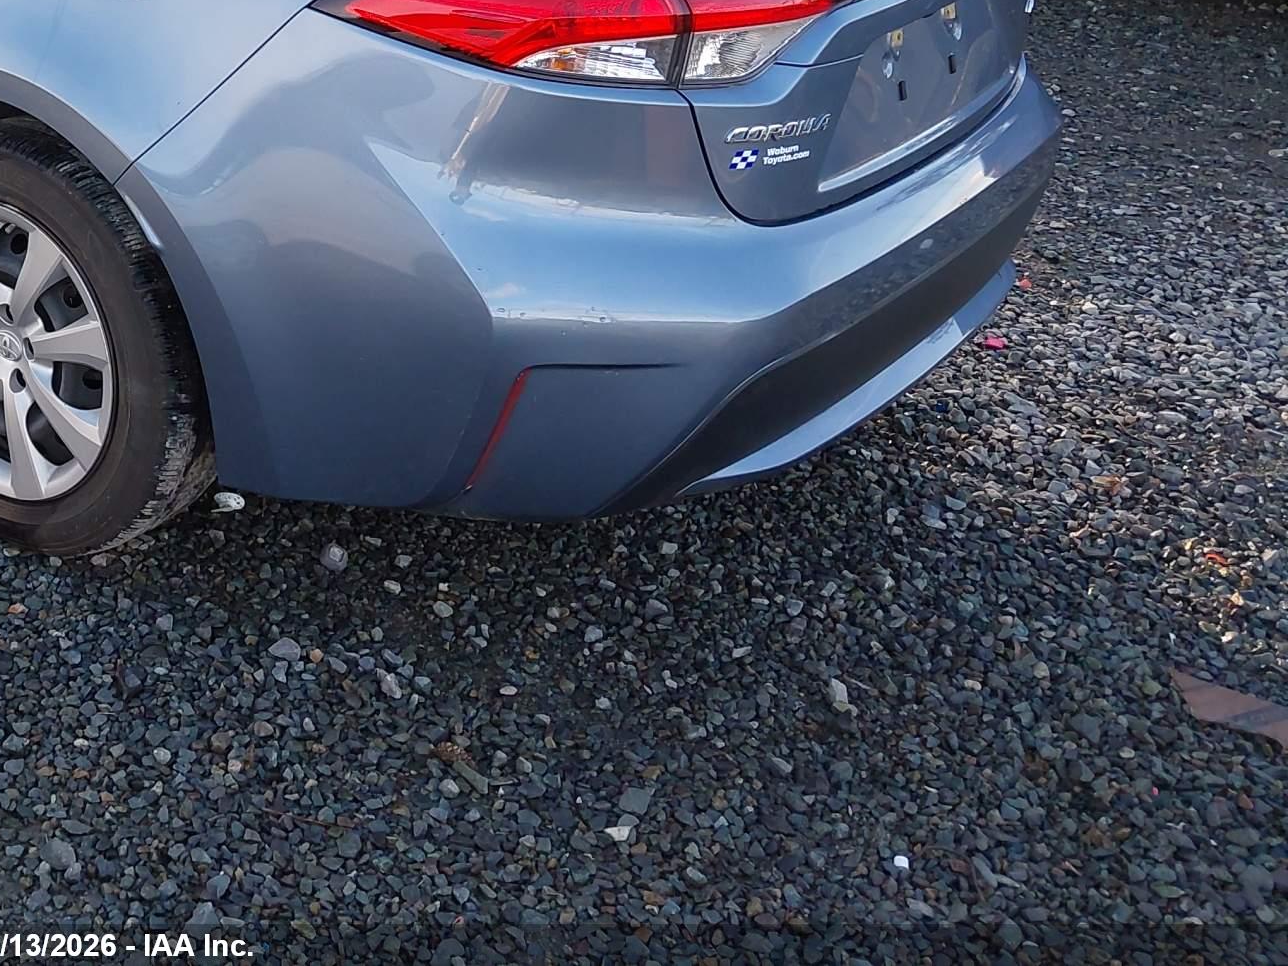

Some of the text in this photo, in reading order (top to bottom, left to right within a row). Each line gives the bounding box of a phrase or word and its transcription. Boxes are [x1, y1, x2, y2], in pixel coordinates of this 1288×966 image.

[725, 114, 831, 143] COROLLA
[767, 145, 799, 156] Woburn
[763, 151, 810, 165] Toyota.com
